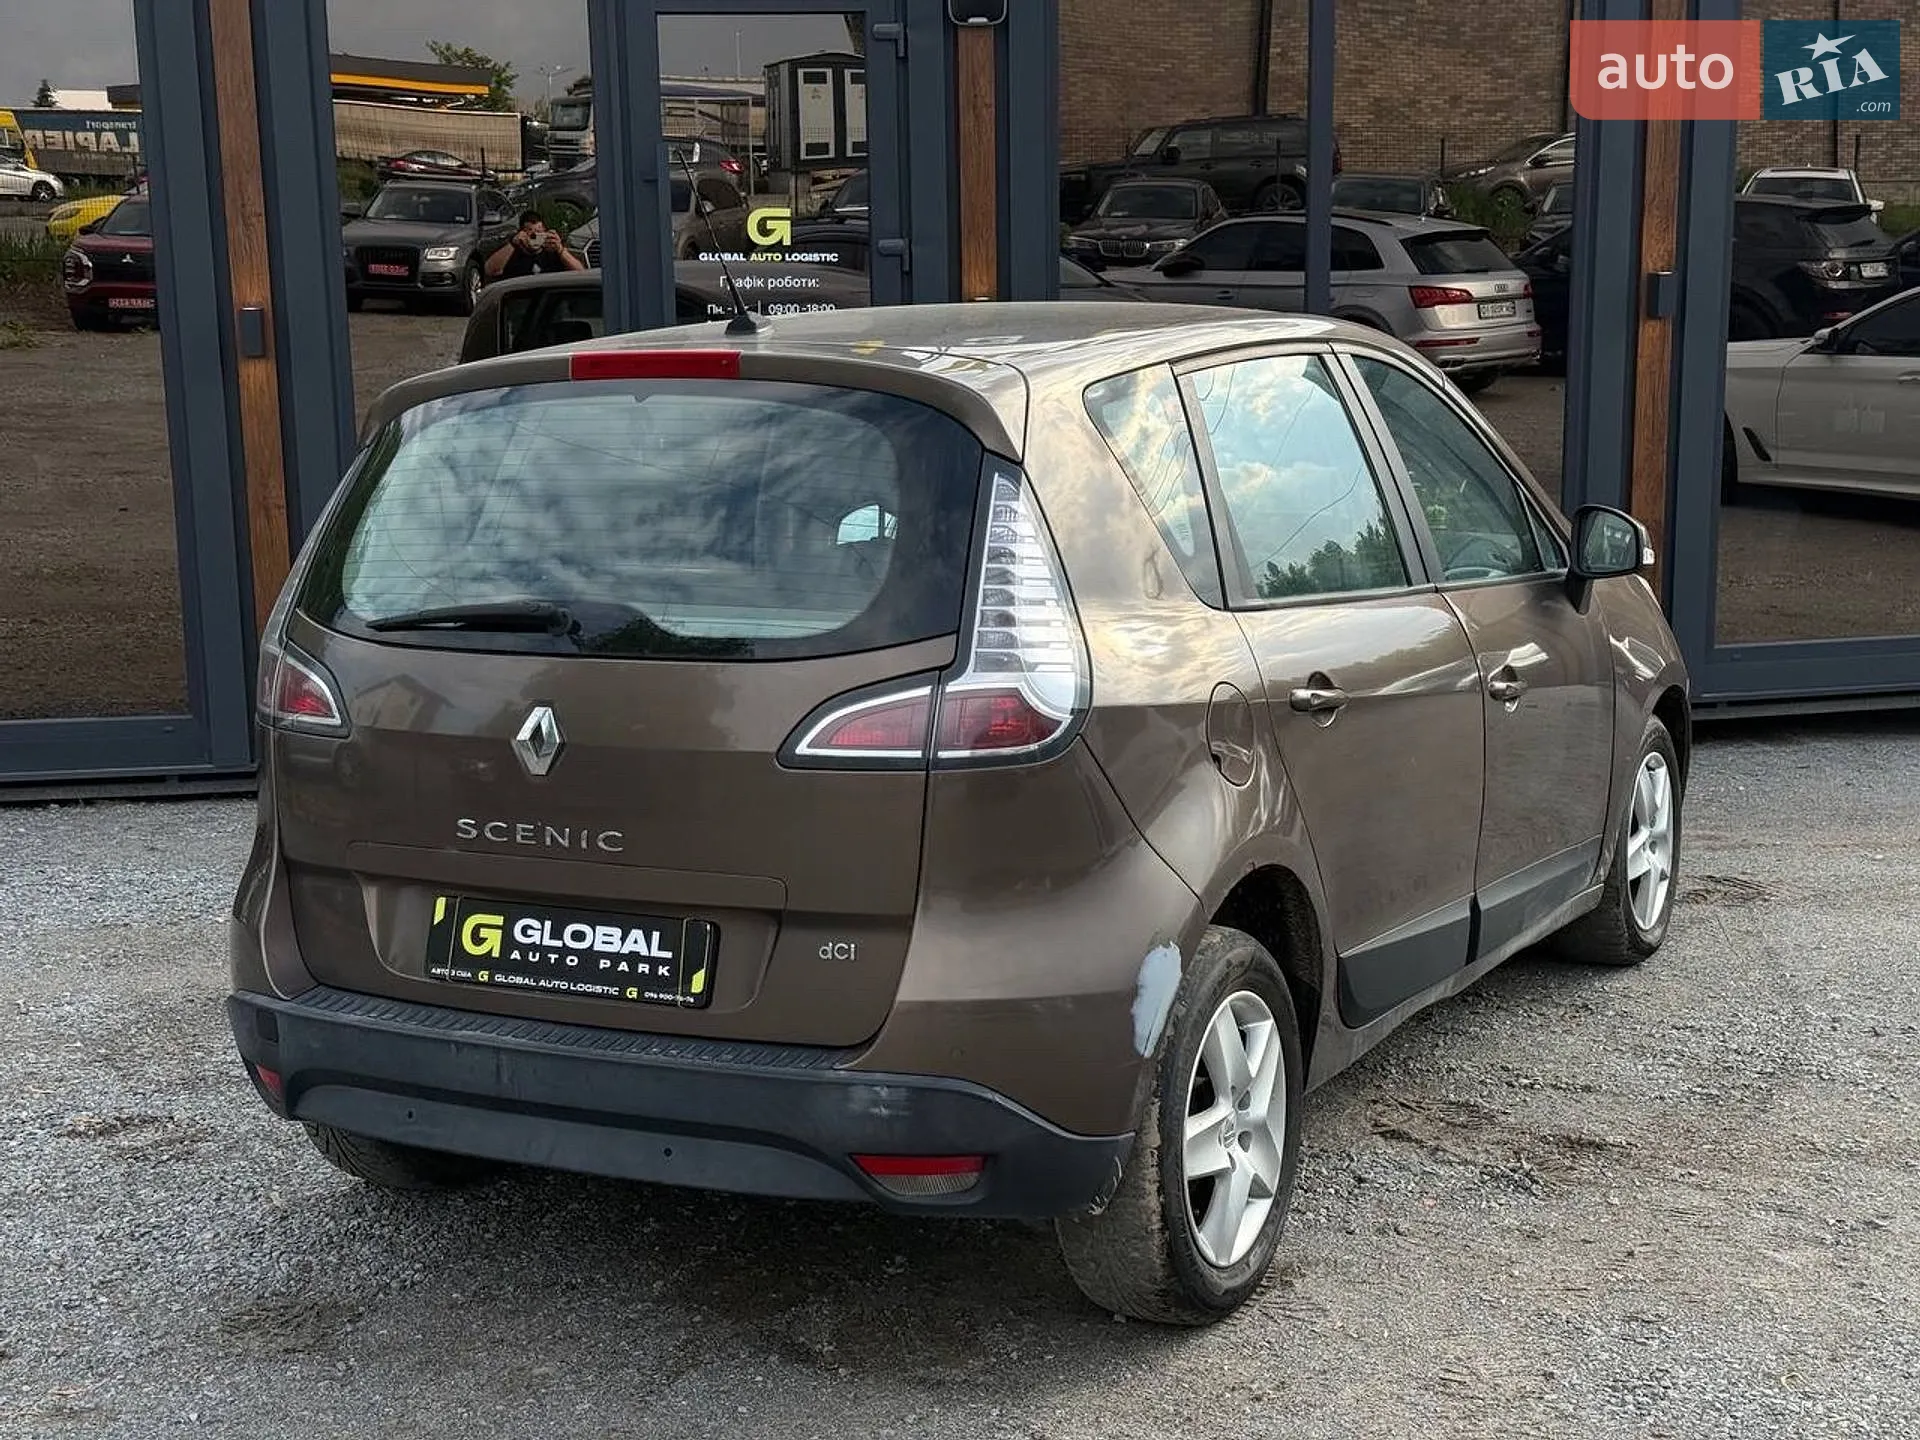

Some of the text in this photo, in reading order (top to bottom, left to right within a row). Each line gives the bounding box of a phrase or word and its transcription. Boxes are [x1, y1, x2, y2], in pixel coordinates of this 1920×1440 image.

[749, 252, 783, 263] AUTO
[785, 252, 839, 263] LOGISTIC
[719, 275, 820, 291] Гафік роботи:
[456, 818, 624, 852] SCENIC
[512, 917, 673, 958] GLOBAL
[510, 949, 670, 976] AUTO PARK
[494, 973, 620, 996] GLOBAL AUTO LOGISTIC
